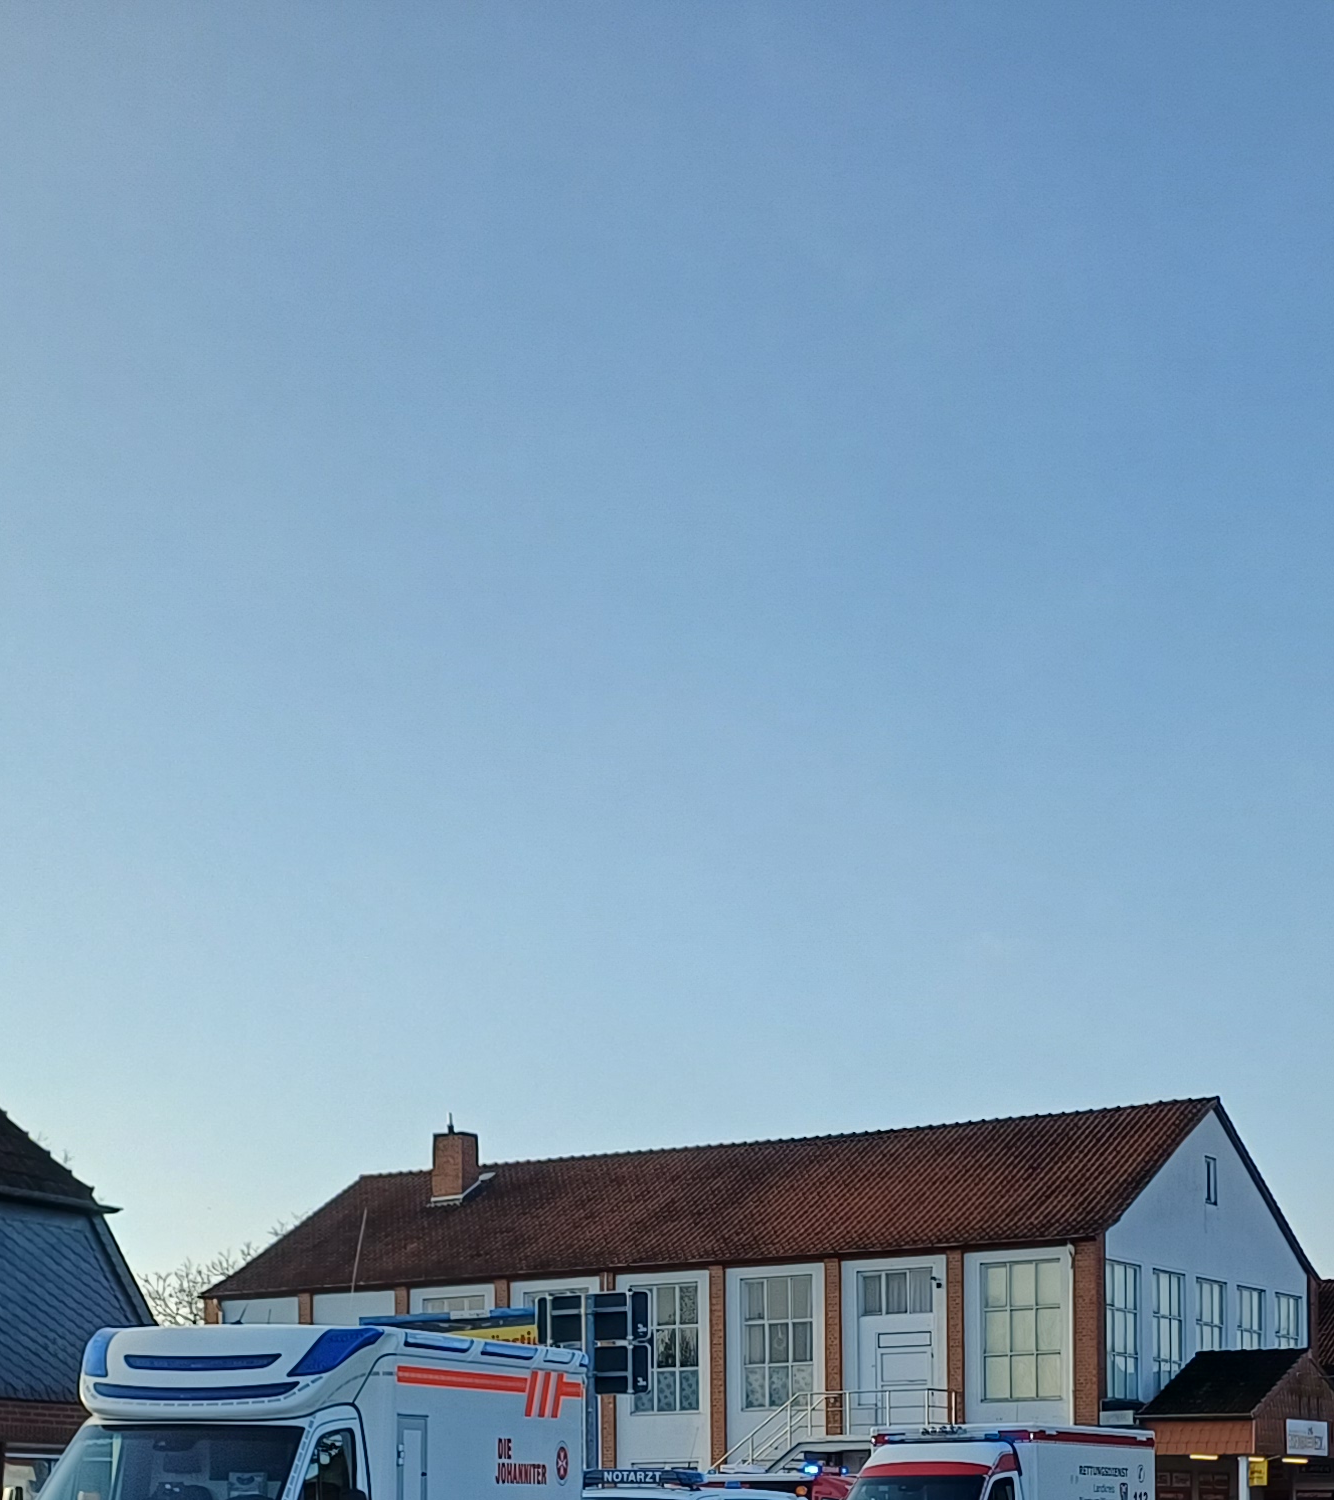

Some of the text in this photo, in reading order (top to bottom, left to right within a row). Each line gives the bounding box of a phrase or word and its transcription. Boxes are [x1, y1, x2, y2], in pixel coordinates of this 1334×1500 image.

[497, 1437, 512, 1459] DIE
[495, 1462, 547, 1485] JOHANNITER
[603, 1471, 663, 1482] NOTARZT
[1078, 1465, 1129, 1478] RETTUNGSDIENST
